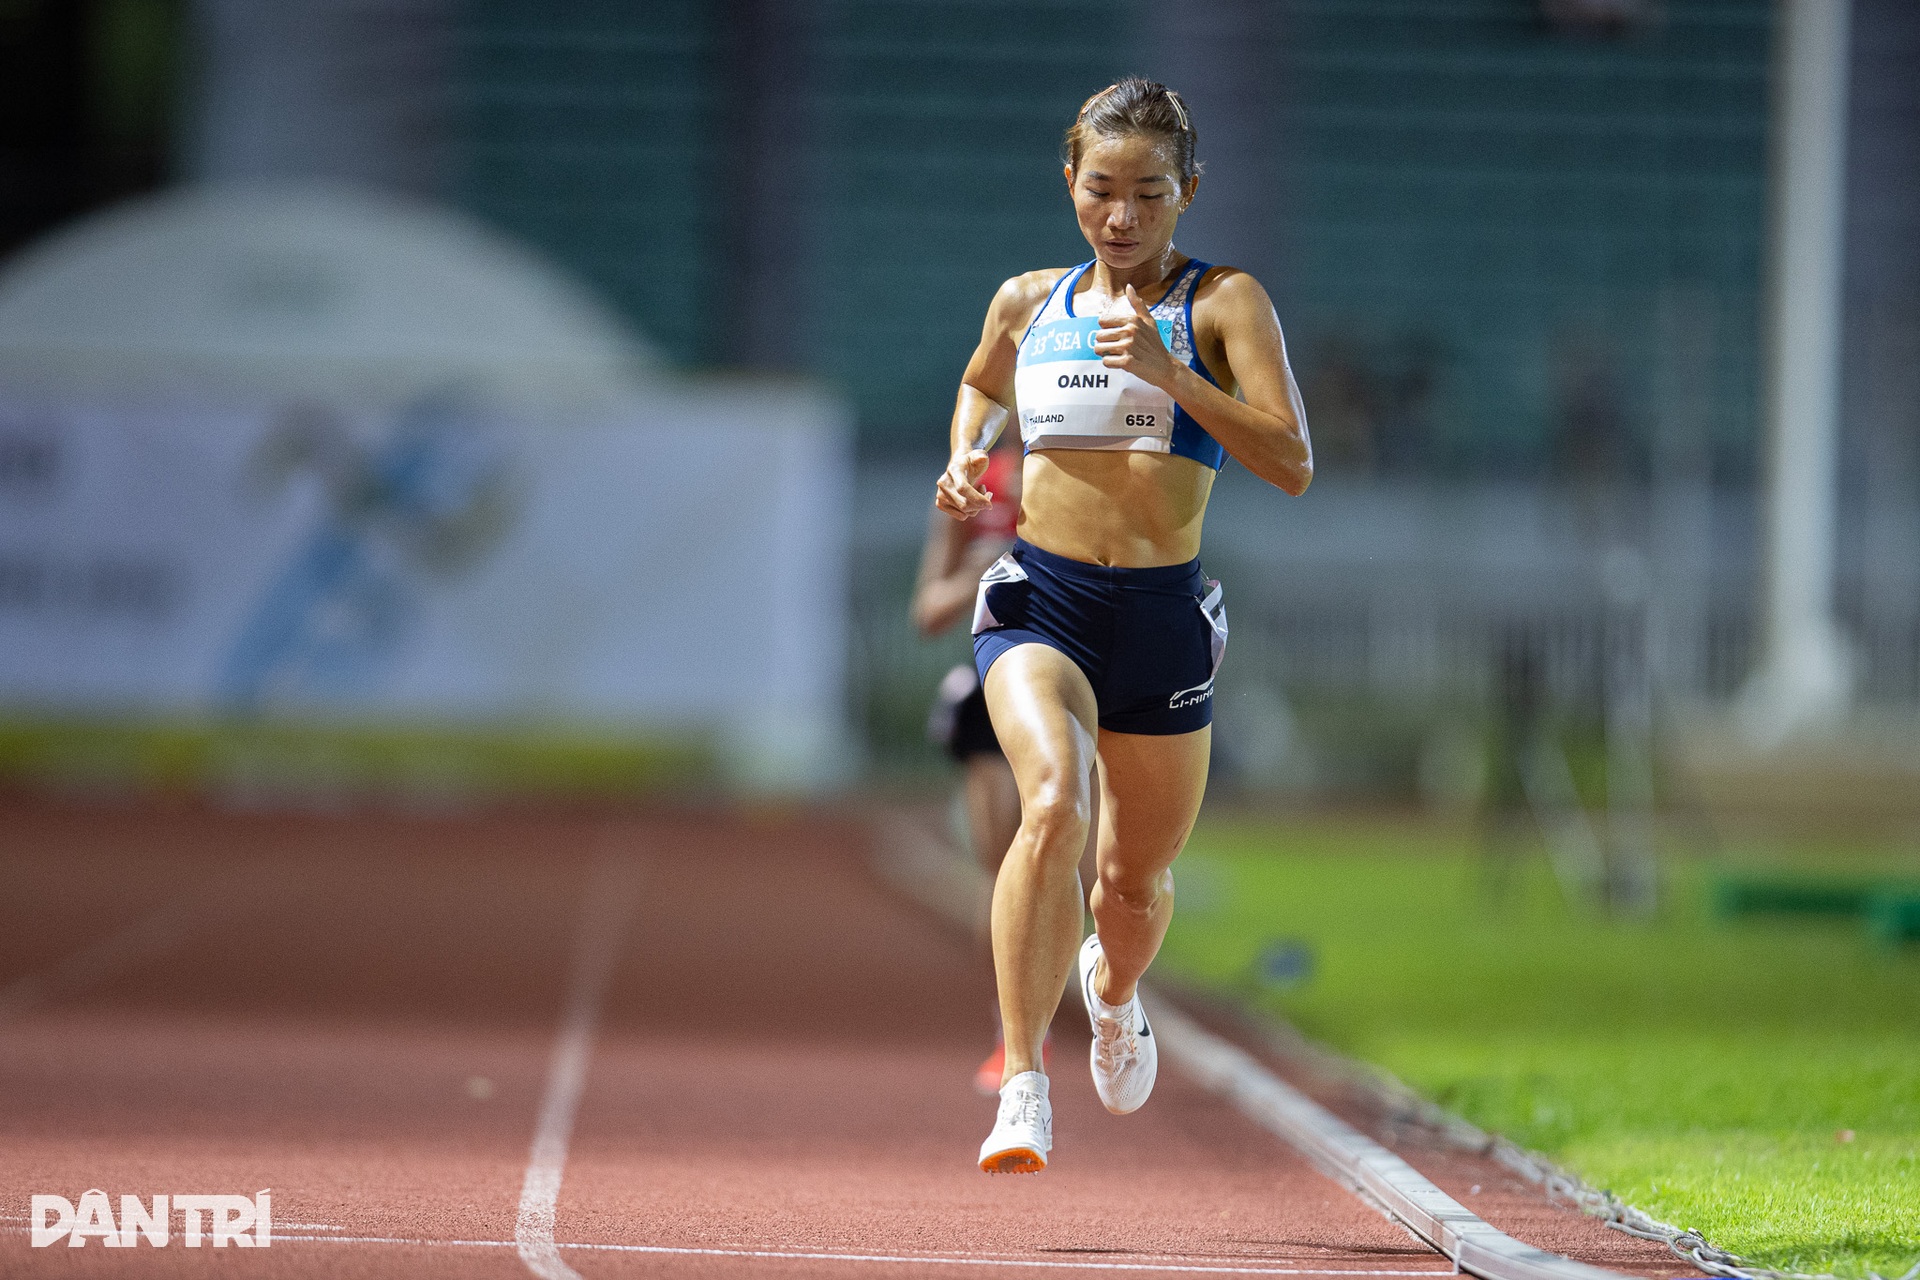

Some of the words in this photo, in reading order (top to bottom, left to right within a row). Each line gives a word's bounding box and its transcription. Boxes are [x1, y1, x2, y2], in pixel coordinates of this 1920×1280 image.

[1053, 333, 1081, 352] SEA
[1057, 374, 1109, 388] OANH
[1125, 414, 1155, 427] 652
